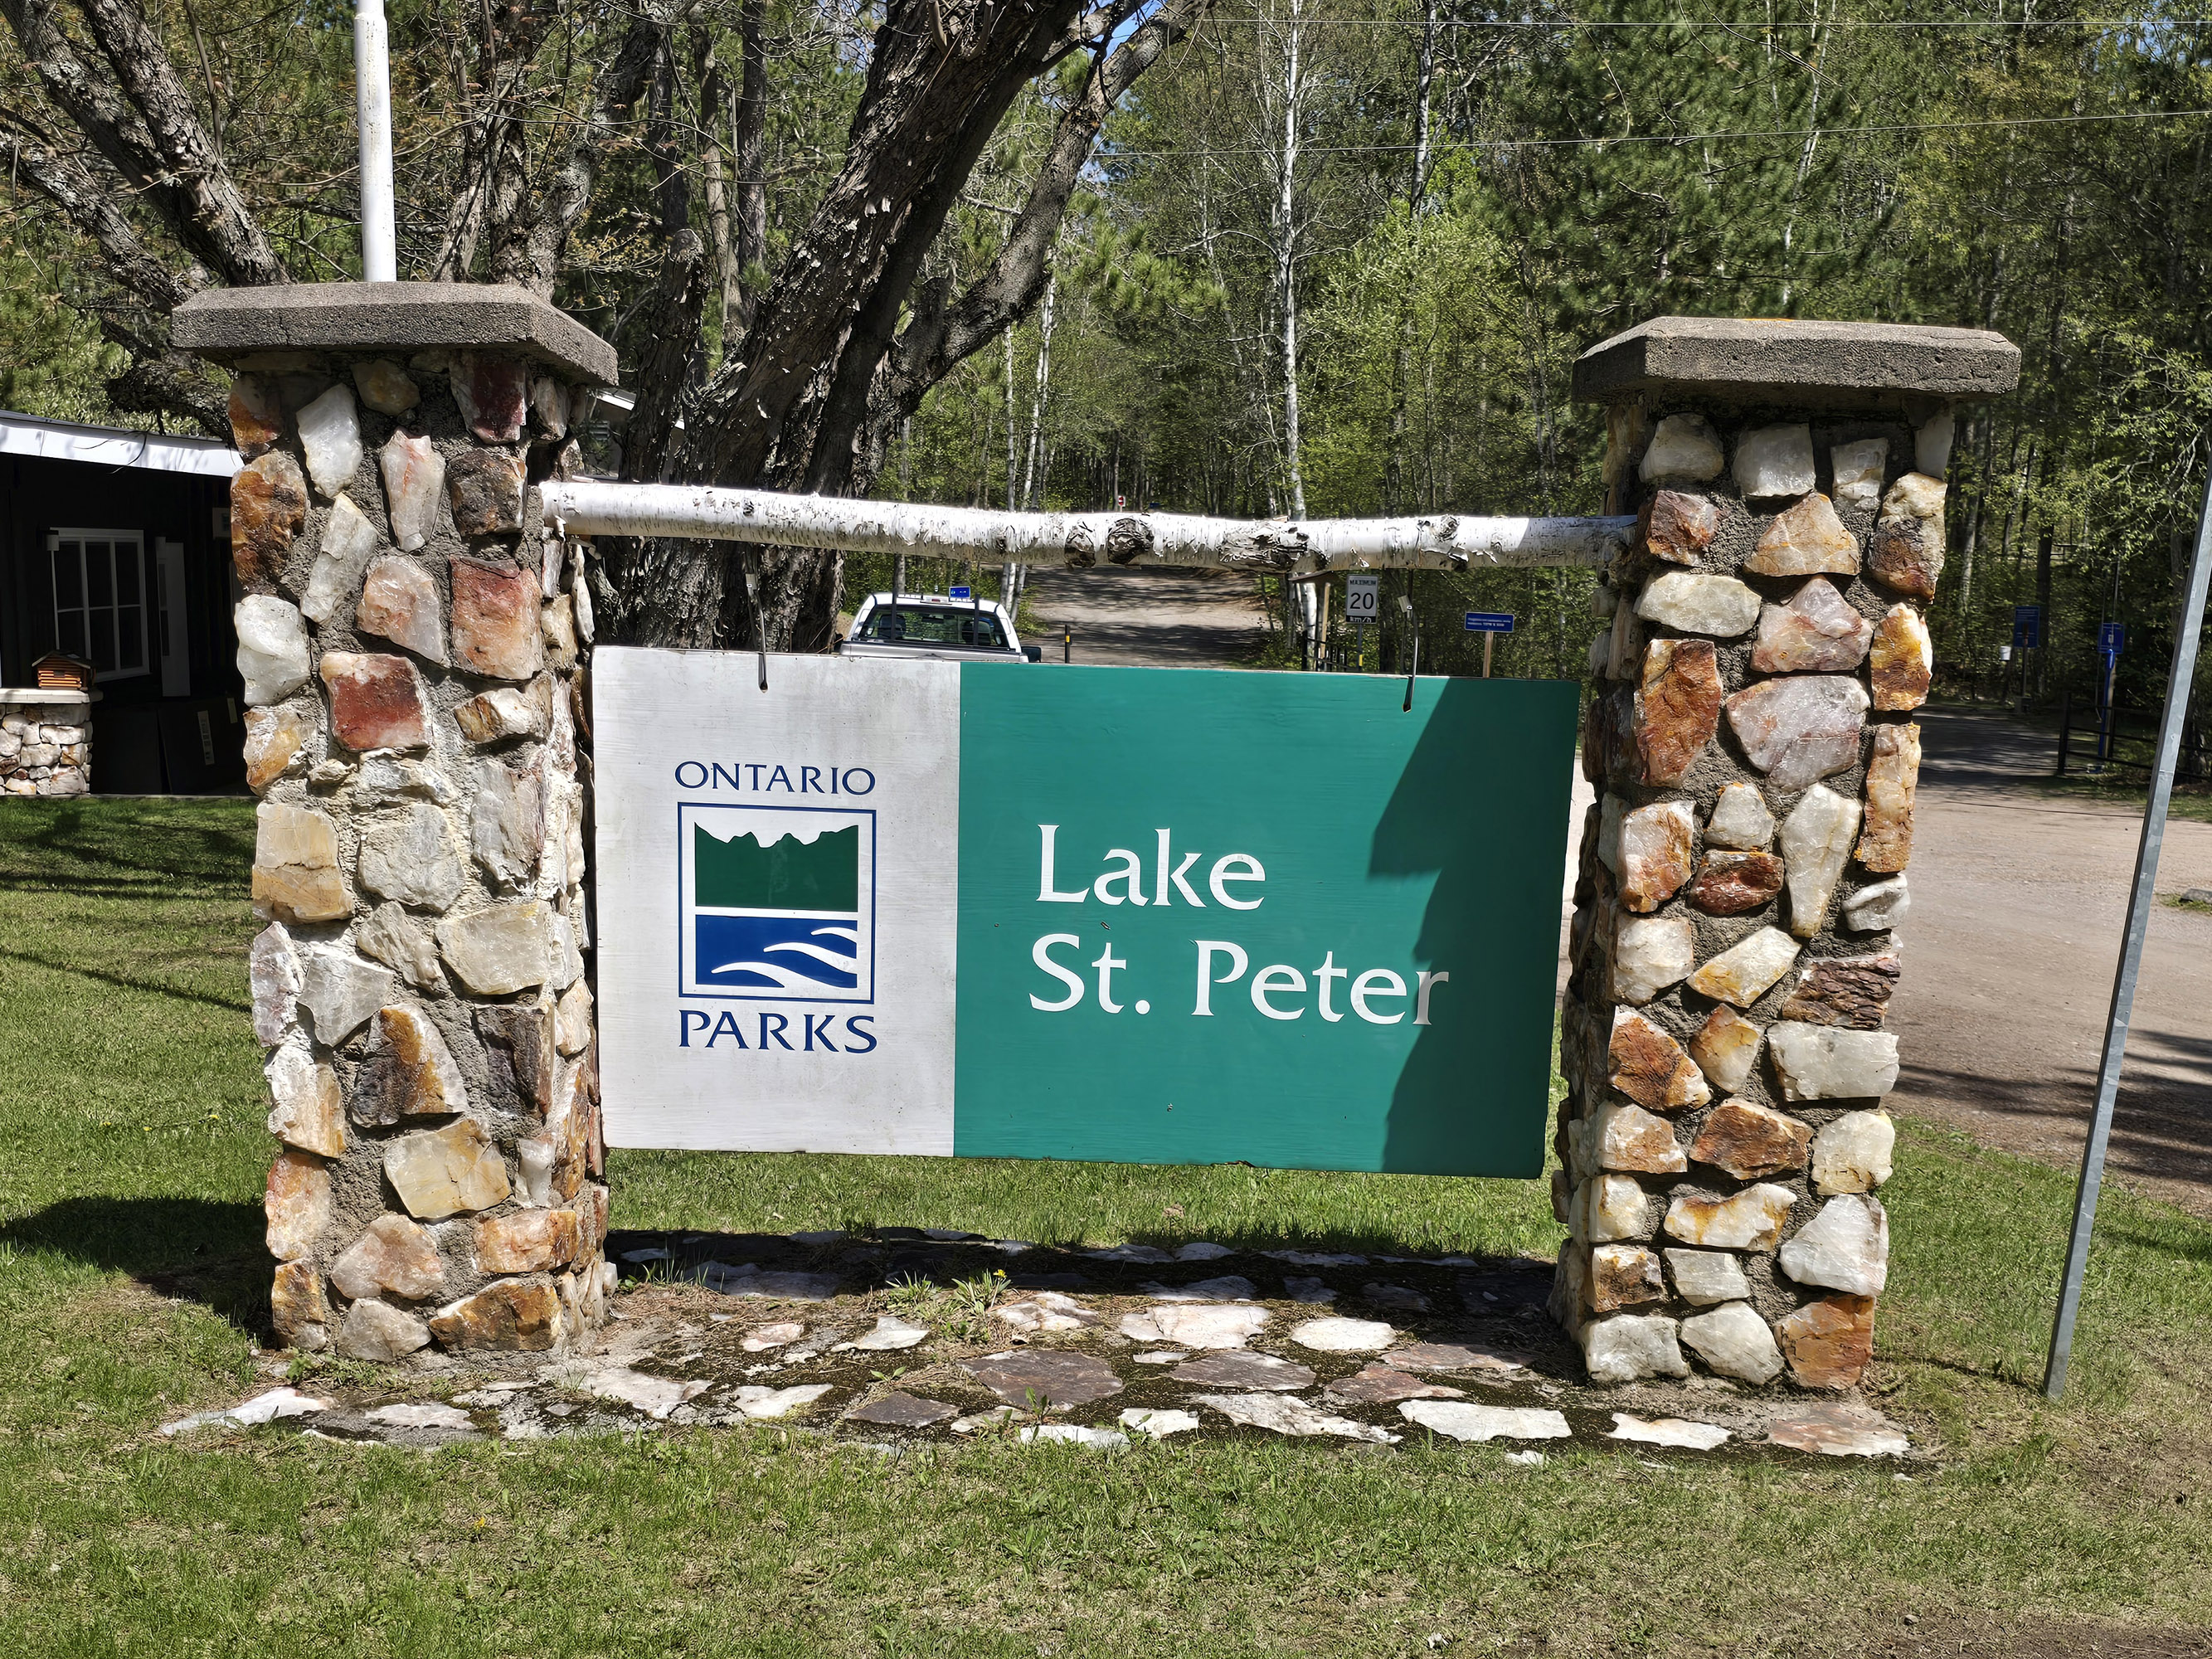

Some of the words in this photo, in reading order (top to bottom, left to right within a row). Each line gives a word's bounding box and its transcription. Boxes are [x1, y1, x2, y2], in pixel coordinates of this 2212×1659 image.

[1349, 591, 1374, 610] 20
[674, 761, 876, 795] ONTARIO
[1036, 825, 1266, 911] Lake
[1029, 933, 1151, 1015] St.
[1191, 940, 1450, 1026] Peter
[678, 1010, 878, 1054] PARKS
